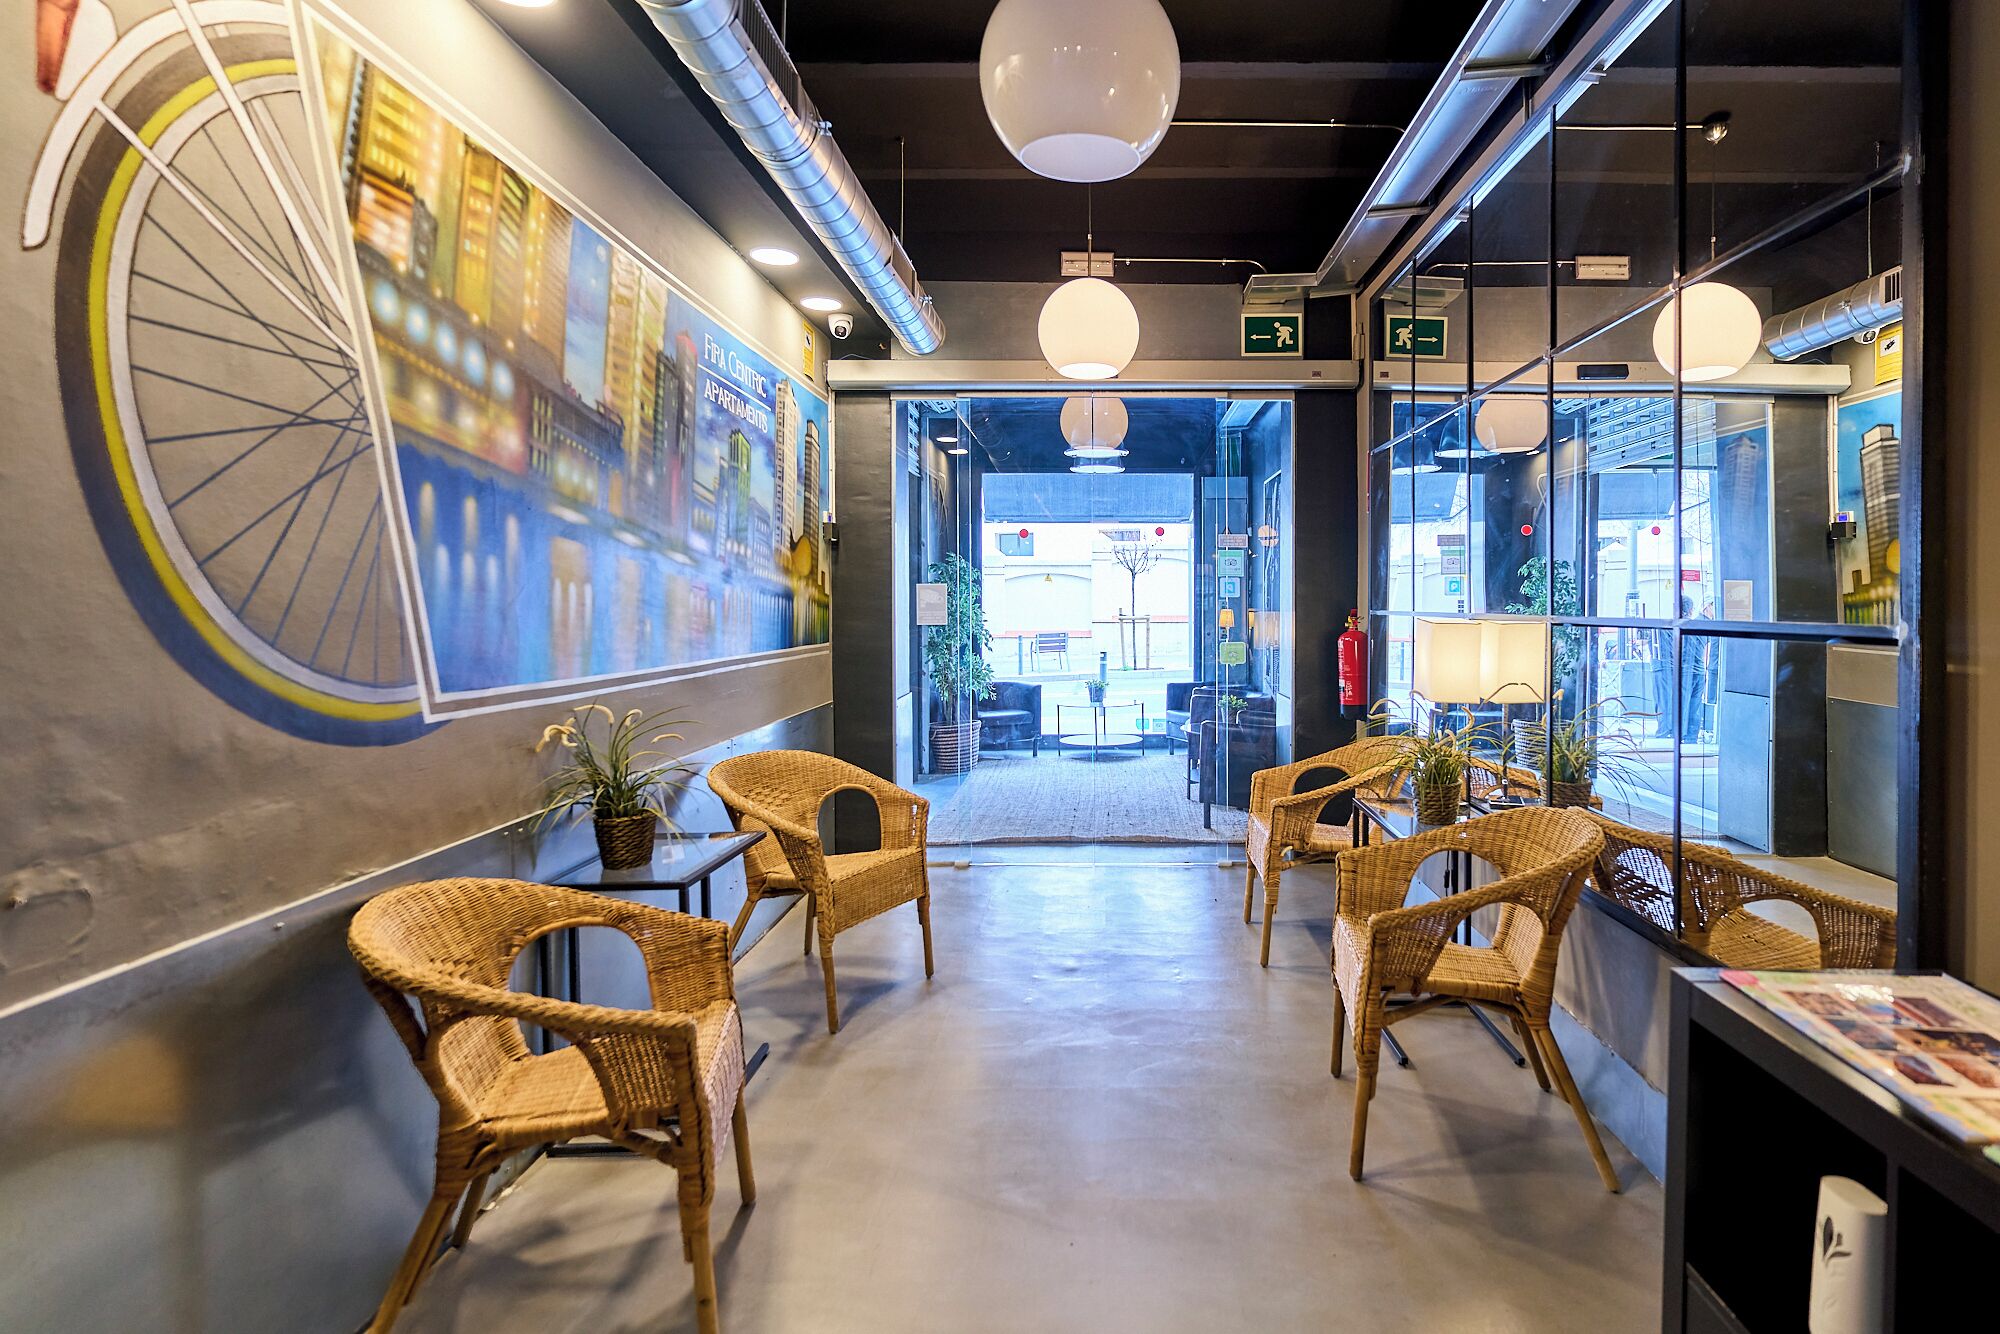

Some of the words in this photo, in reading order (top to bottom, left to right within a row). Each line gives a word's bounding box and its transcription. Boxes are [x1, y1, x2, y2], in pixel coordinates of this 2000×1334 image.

[704, 333, 726, 370] FIRA
[728, 351, 767, 398] CENTRIC
[704, 378, 768, 433] APARTAMENTS
